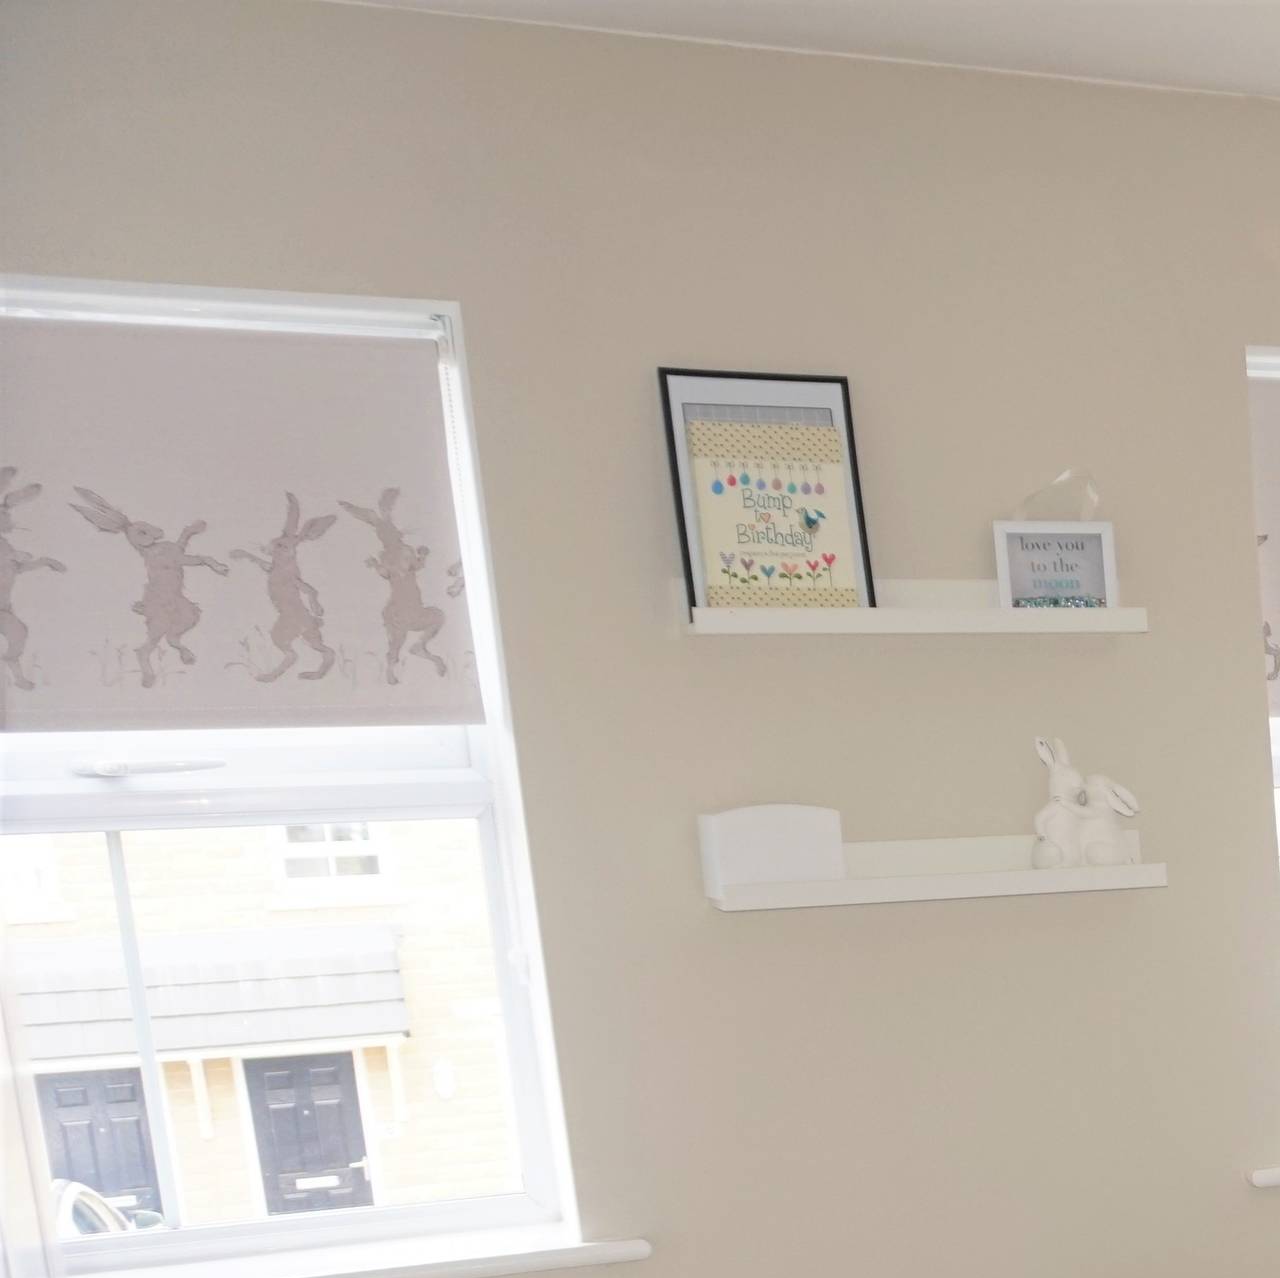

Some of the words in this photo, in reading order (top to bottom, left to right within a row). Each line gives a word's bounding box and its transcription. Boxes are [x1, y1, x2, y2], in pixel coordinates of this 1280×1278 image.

[742, 488, 793, 517] Bump
[736, 522, 813, 552] Birthday
[1019, 536, 1051, 551] love
[1056, 540, 1085, 556] you
[1031, 560, 1047, 573] to
[1053, 558, 1079, 573] the
